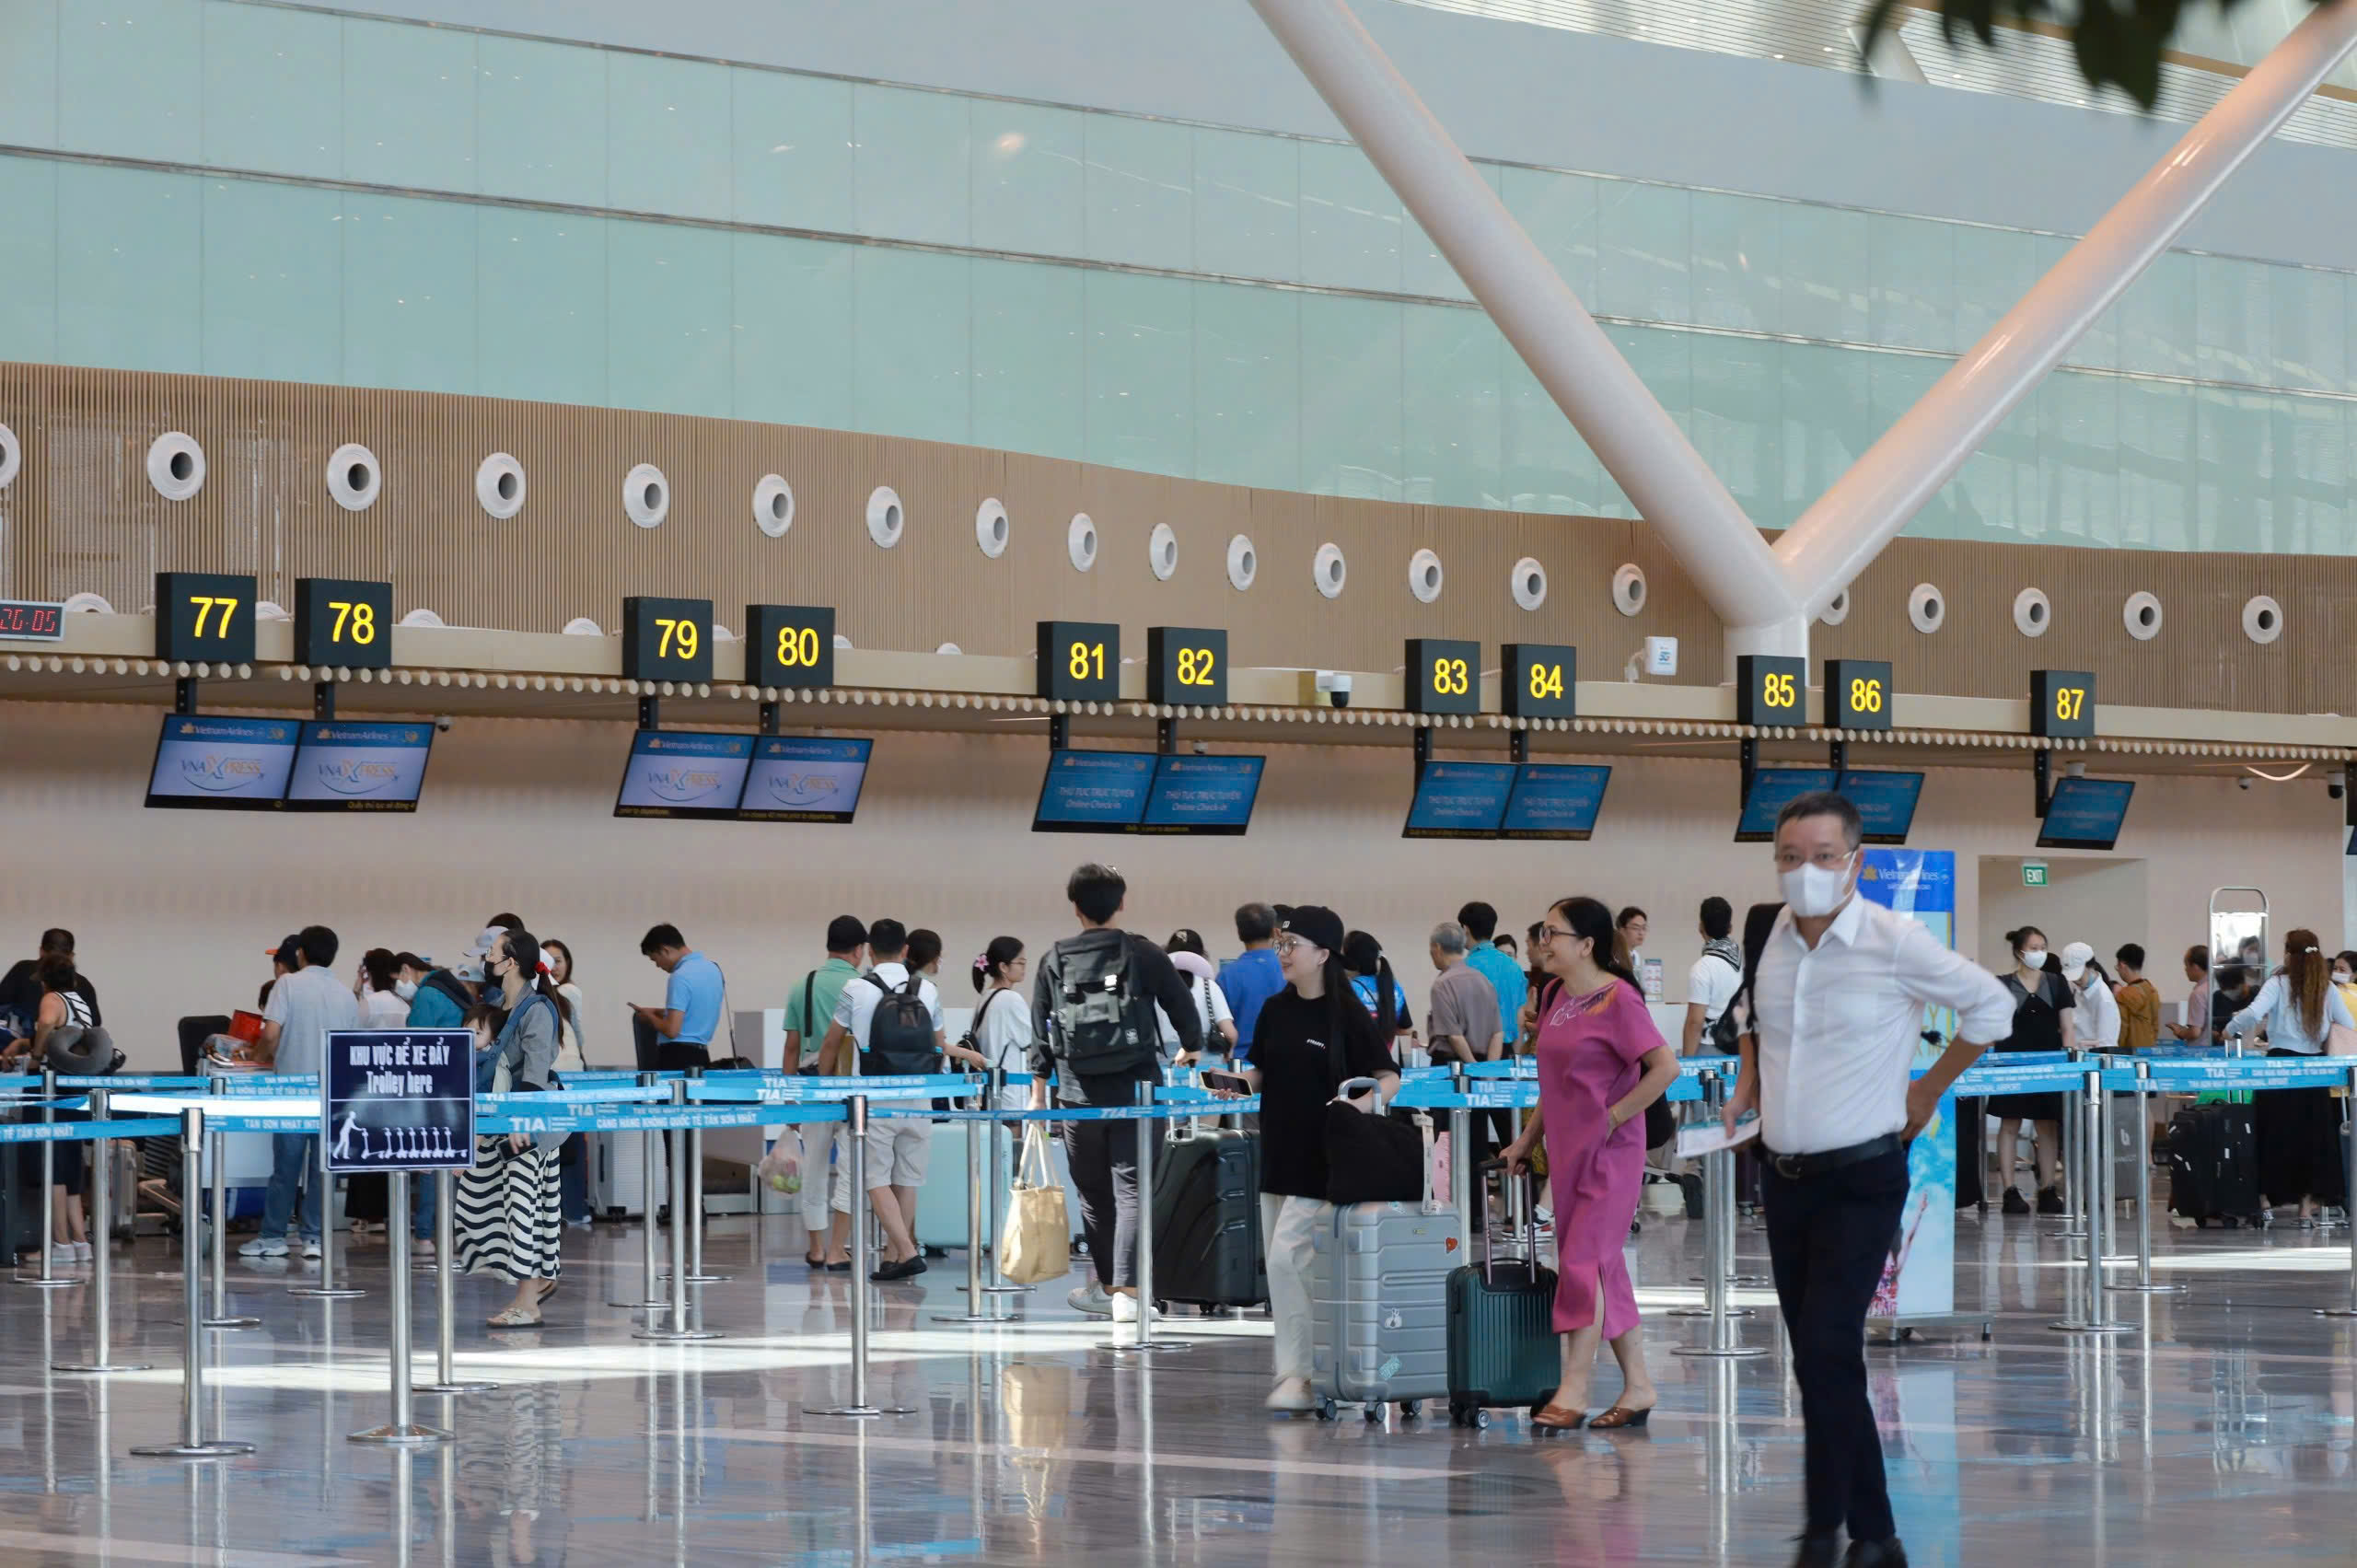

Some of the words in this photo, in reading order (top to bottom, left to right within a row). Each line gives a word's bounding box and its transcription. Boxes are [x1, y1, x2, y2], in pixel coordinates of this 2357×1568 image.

[191, 598, 237, 638] 77
[330, 602, 374, 644] 78
[656, 620, 697, 658] 79
[778, 627, 819, 667] 80
[1070, 643, 1104, 679] 81
[1178, 648, 1213, 685] 82
[1434, 658, 1468, 694] 83
[1530, 664, 1563, 699] 84
[1764, 674, 1794, 707] 85
[1852, 679, 1881, 712] 86
[2057, 689, 2084, 719] 87
[2026, 869, 2043, 883] EXIT
[350, 1045, 370, 1066] KHU
[372, 1042, 393, 1071] VỰC
[395, 1036, 411, 1066] ĐỂ
[412, 1045, 426, 1065] XE
[428, 1036, 450, 1065] ĐẨY
[366, 1071, 405, 1098] Trolley
[407, 1071, 433, 1094] here
[763, 1077, 788, 1087] TIA
[1509, 1067, 1529, 1076] TIA
[2136, 1079, 2158, 1090] TIA
[2205, 1068, 2225, 1077] TIA
[485, 1093, 505, 1101] TIA
[756, 1089, 781, 1100] TIA
[1465, 1094, 1492, 1106] TIA
[1477, 1082, 1495, 1092] TIA
[567, 1105, 594, 1116] TIA
[1099, 1108, 1127, 1118] TIA
[509, 1117, 546, 1132] TIA
